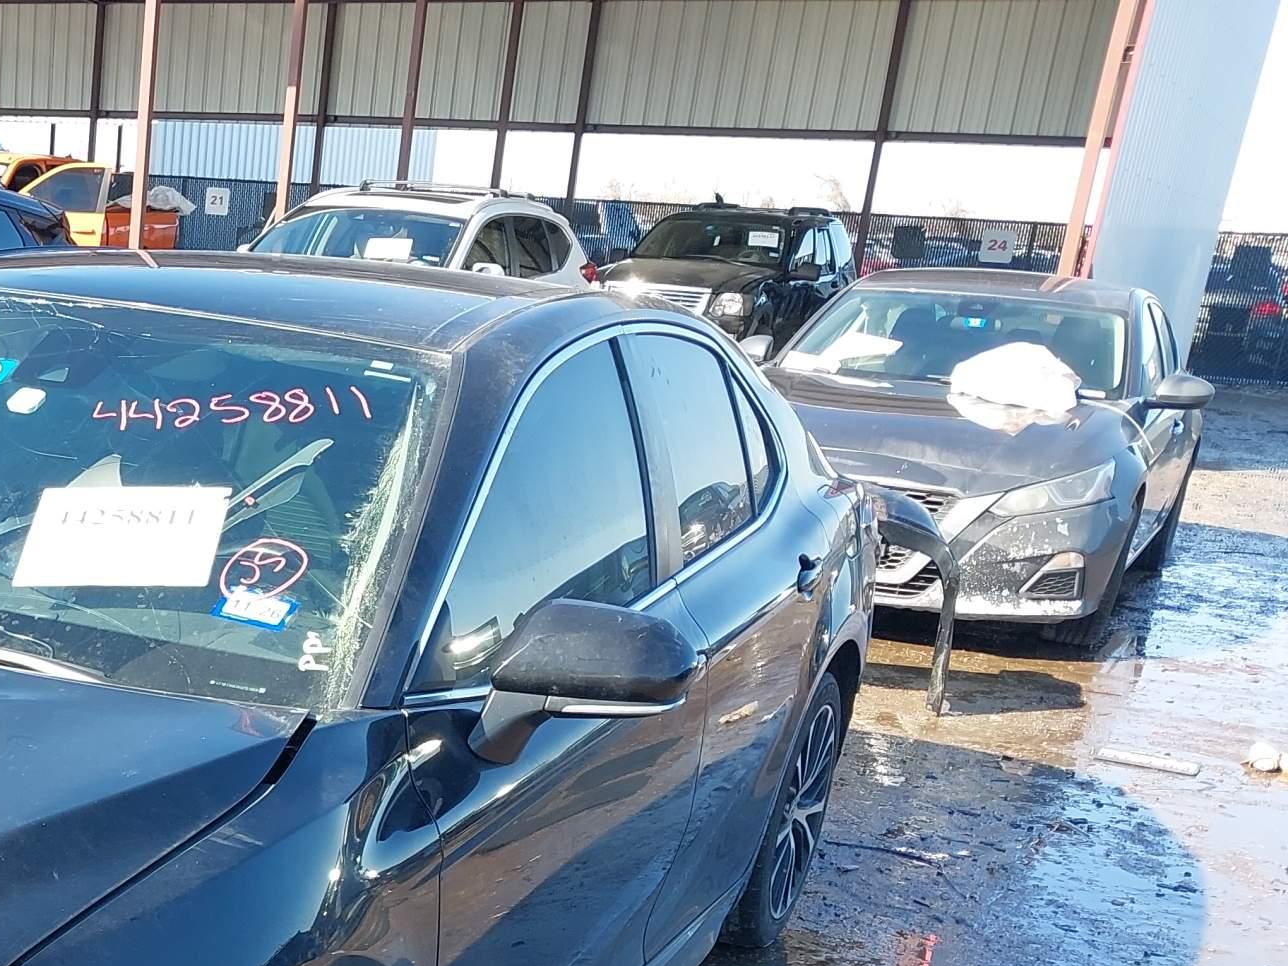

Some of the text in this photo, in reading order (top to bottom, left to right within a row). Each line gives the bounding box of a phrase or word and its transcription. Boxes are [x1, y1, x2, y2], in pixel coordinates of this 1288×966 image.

[210, 195, 223, 206] 21
[987, 239, 1008, 252] 24
[92, 385, 372, 431] 44258811
